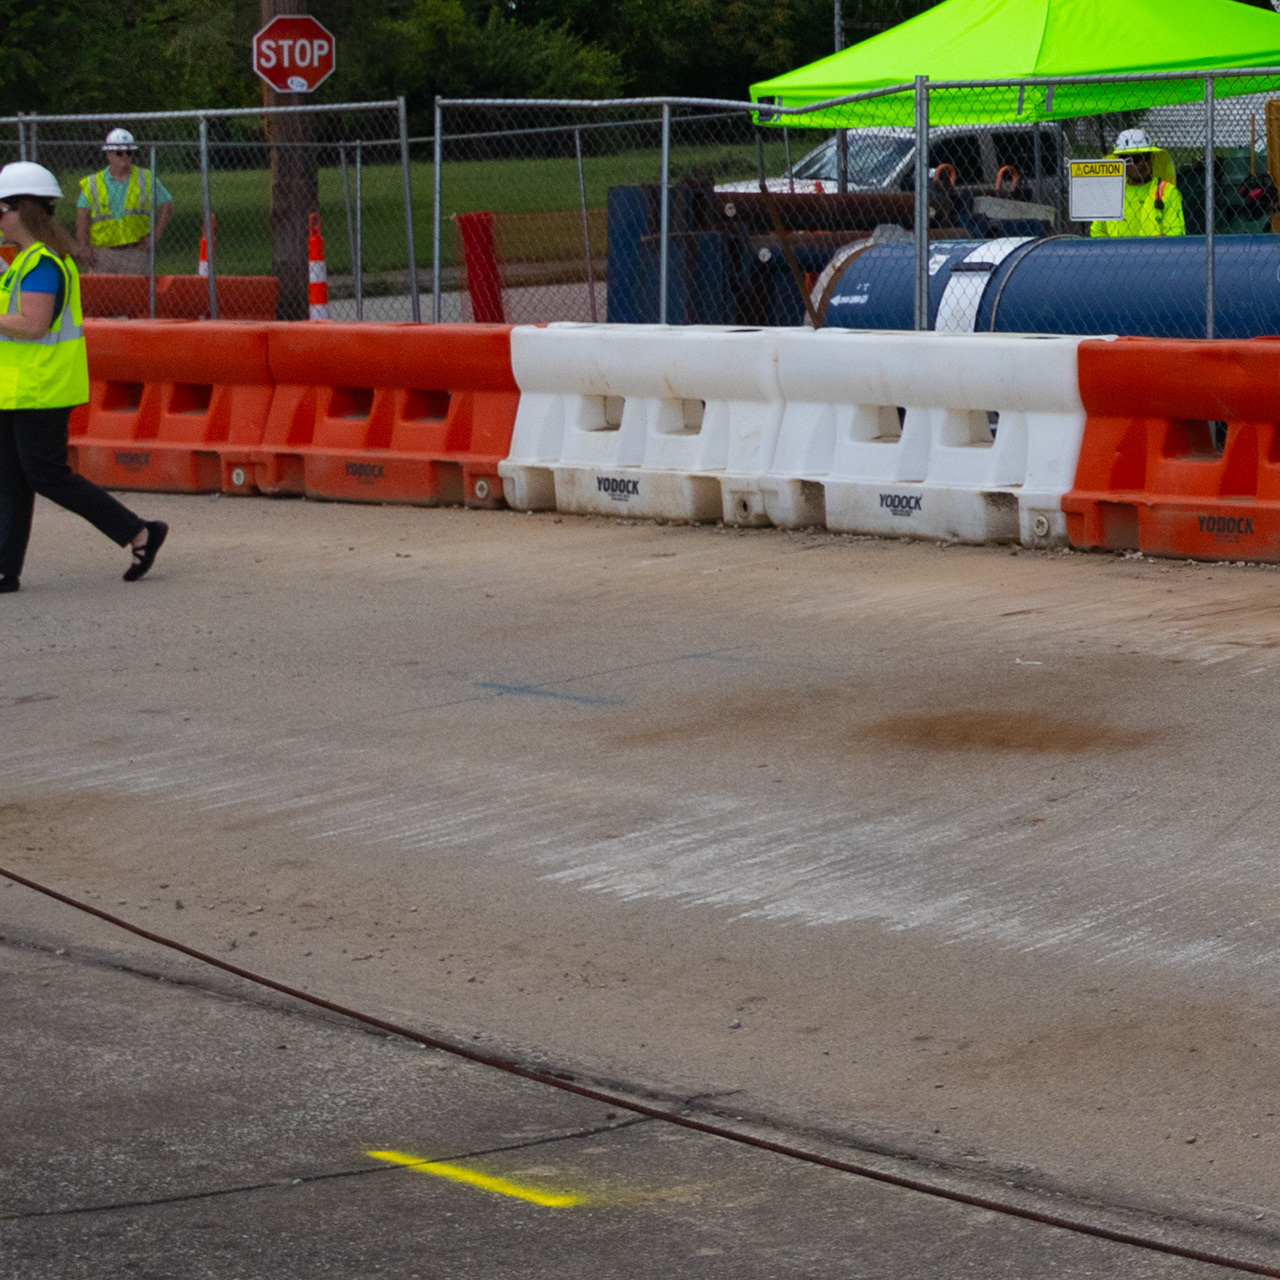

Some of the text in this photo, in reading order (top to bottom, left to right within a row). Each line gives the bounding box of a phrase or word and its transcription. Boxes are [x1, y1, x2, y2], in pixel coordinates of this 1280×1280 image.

[260, 39, 329, 68] STOP
[1083, 164, 1120, 175] CAUTION
[597, 476, 639, 495] YODOCK
[879, 493, 922, 510] YODOCK
[1198, 515, 1254, 535] YODOCK
